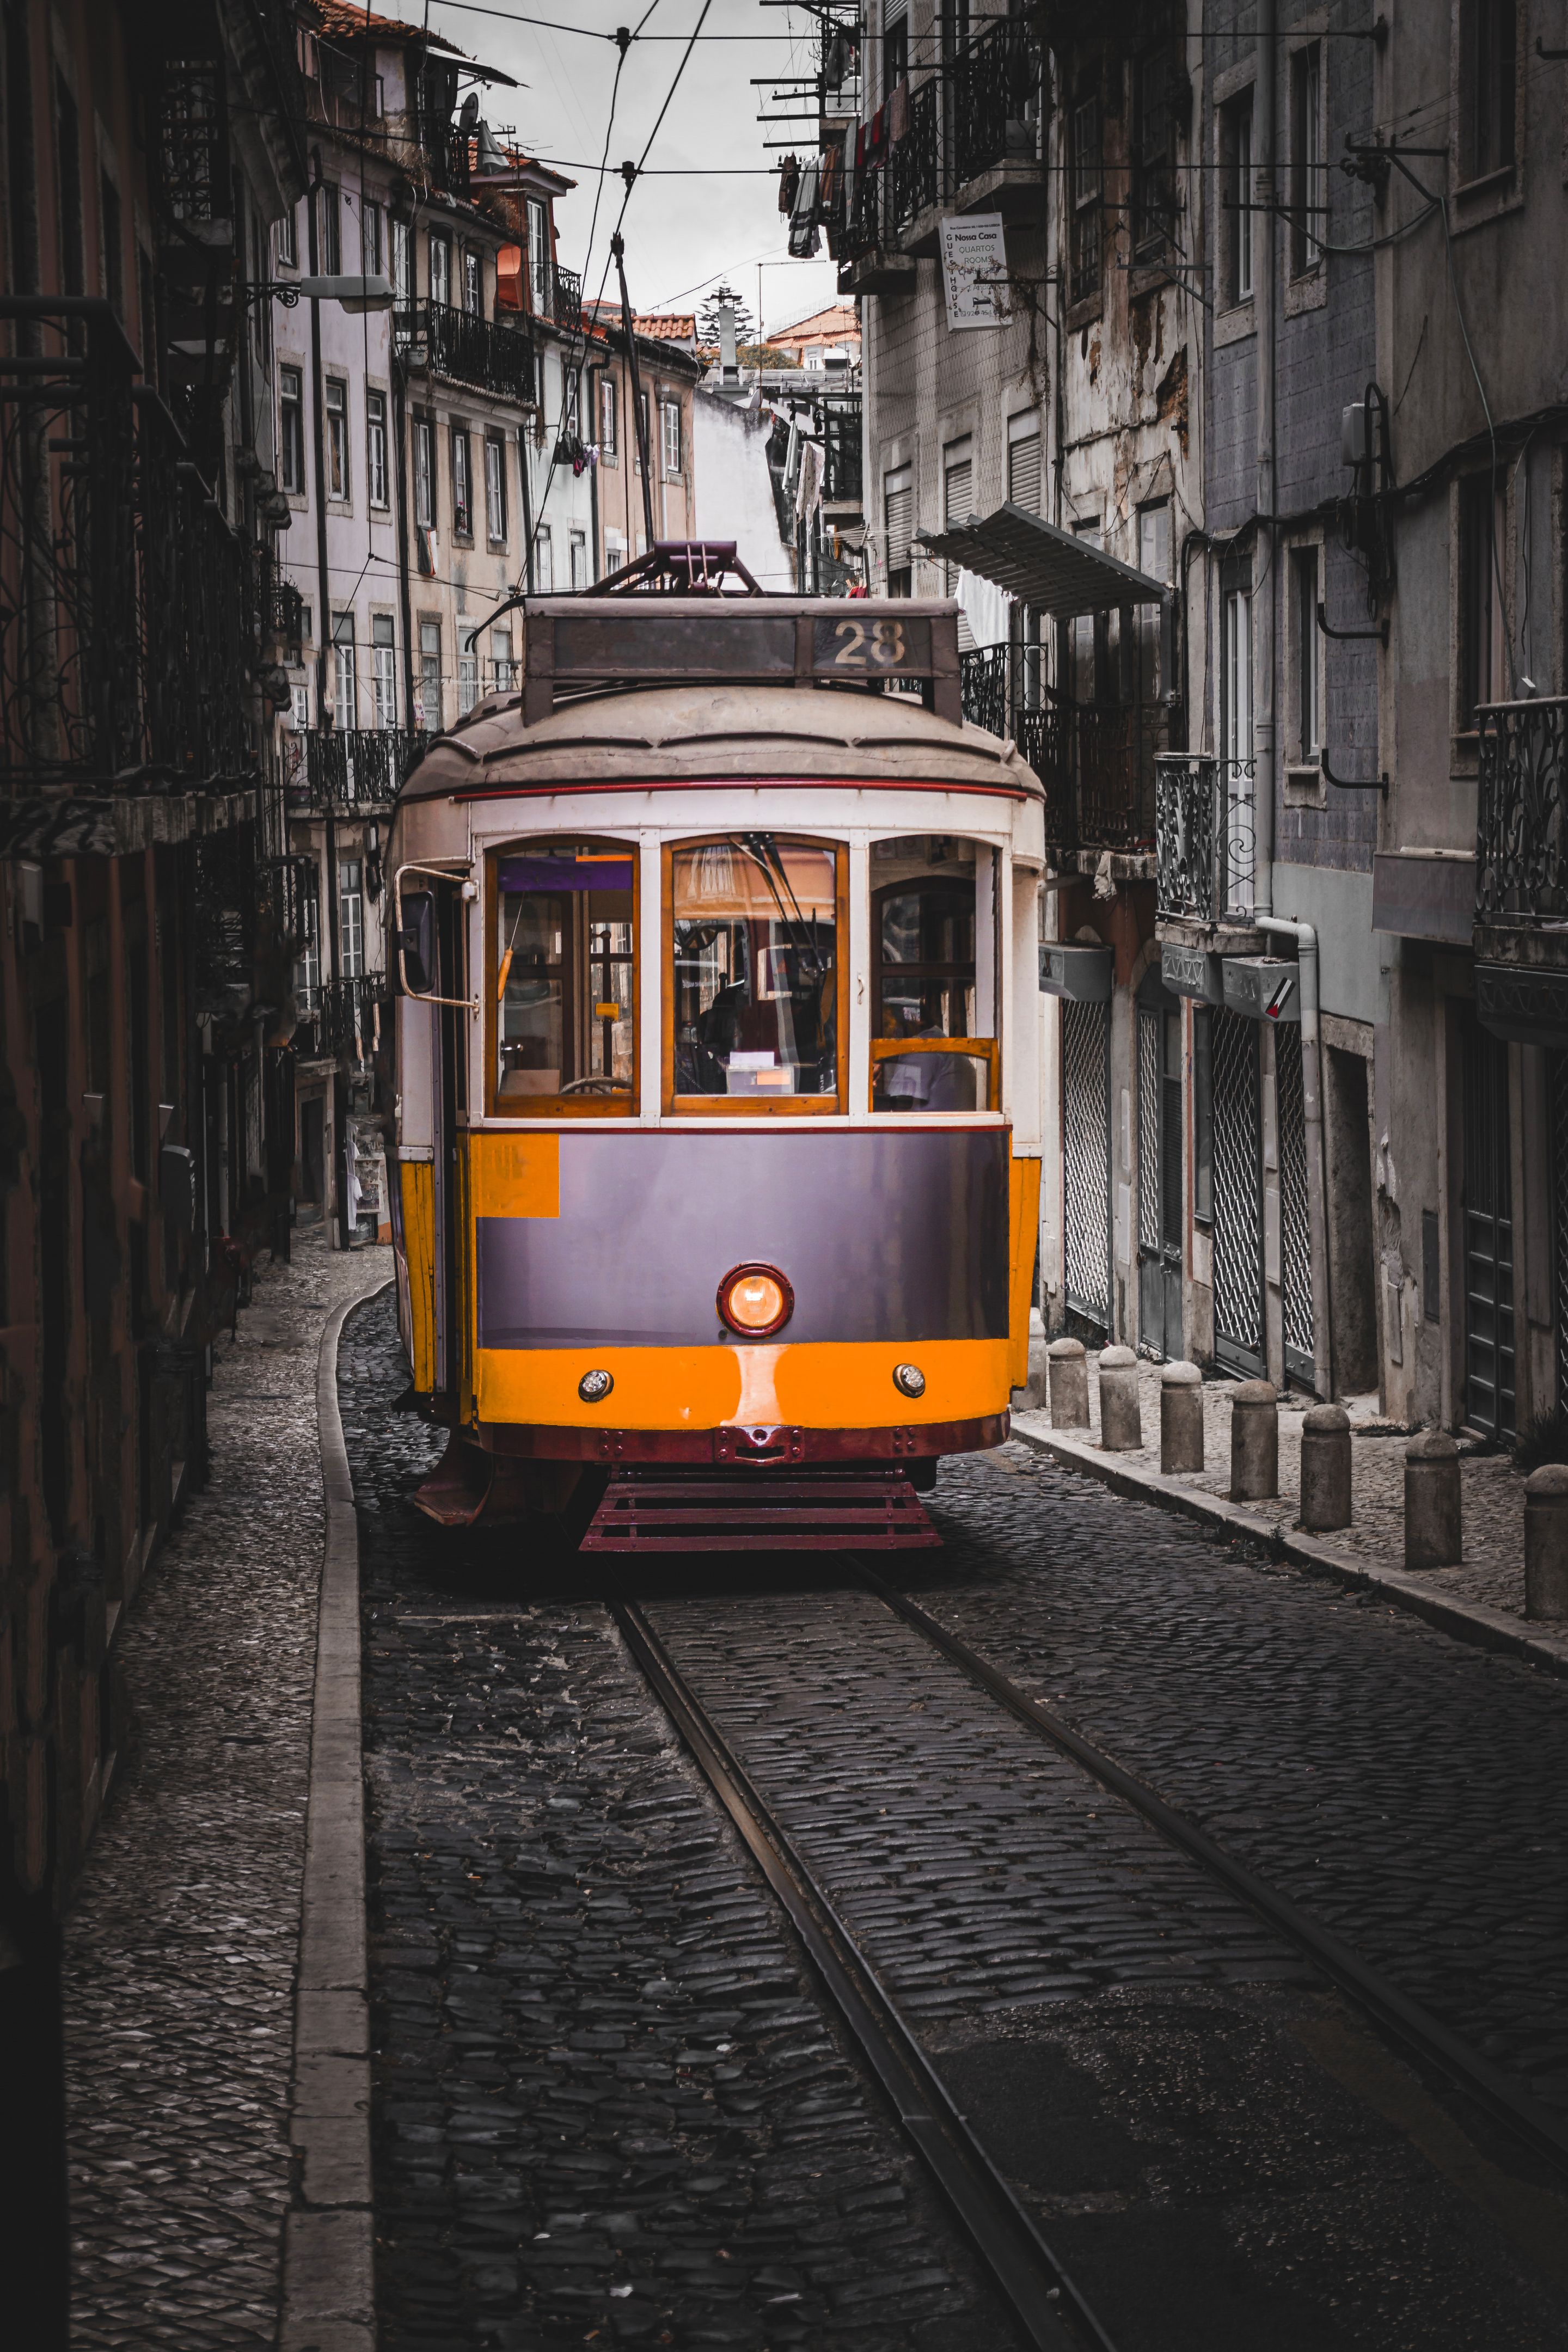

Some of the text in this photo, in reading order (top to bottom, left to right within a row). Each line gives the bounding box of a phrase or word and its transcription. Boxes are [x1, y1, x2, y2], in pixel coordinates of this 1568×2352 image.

[955, 232, 997, 242] Nossa Casa
[959, 244, 995, 254] QUARTOS
[964, 256, 992, 264] ROOMS
[835, 620, 905, 664] 28
